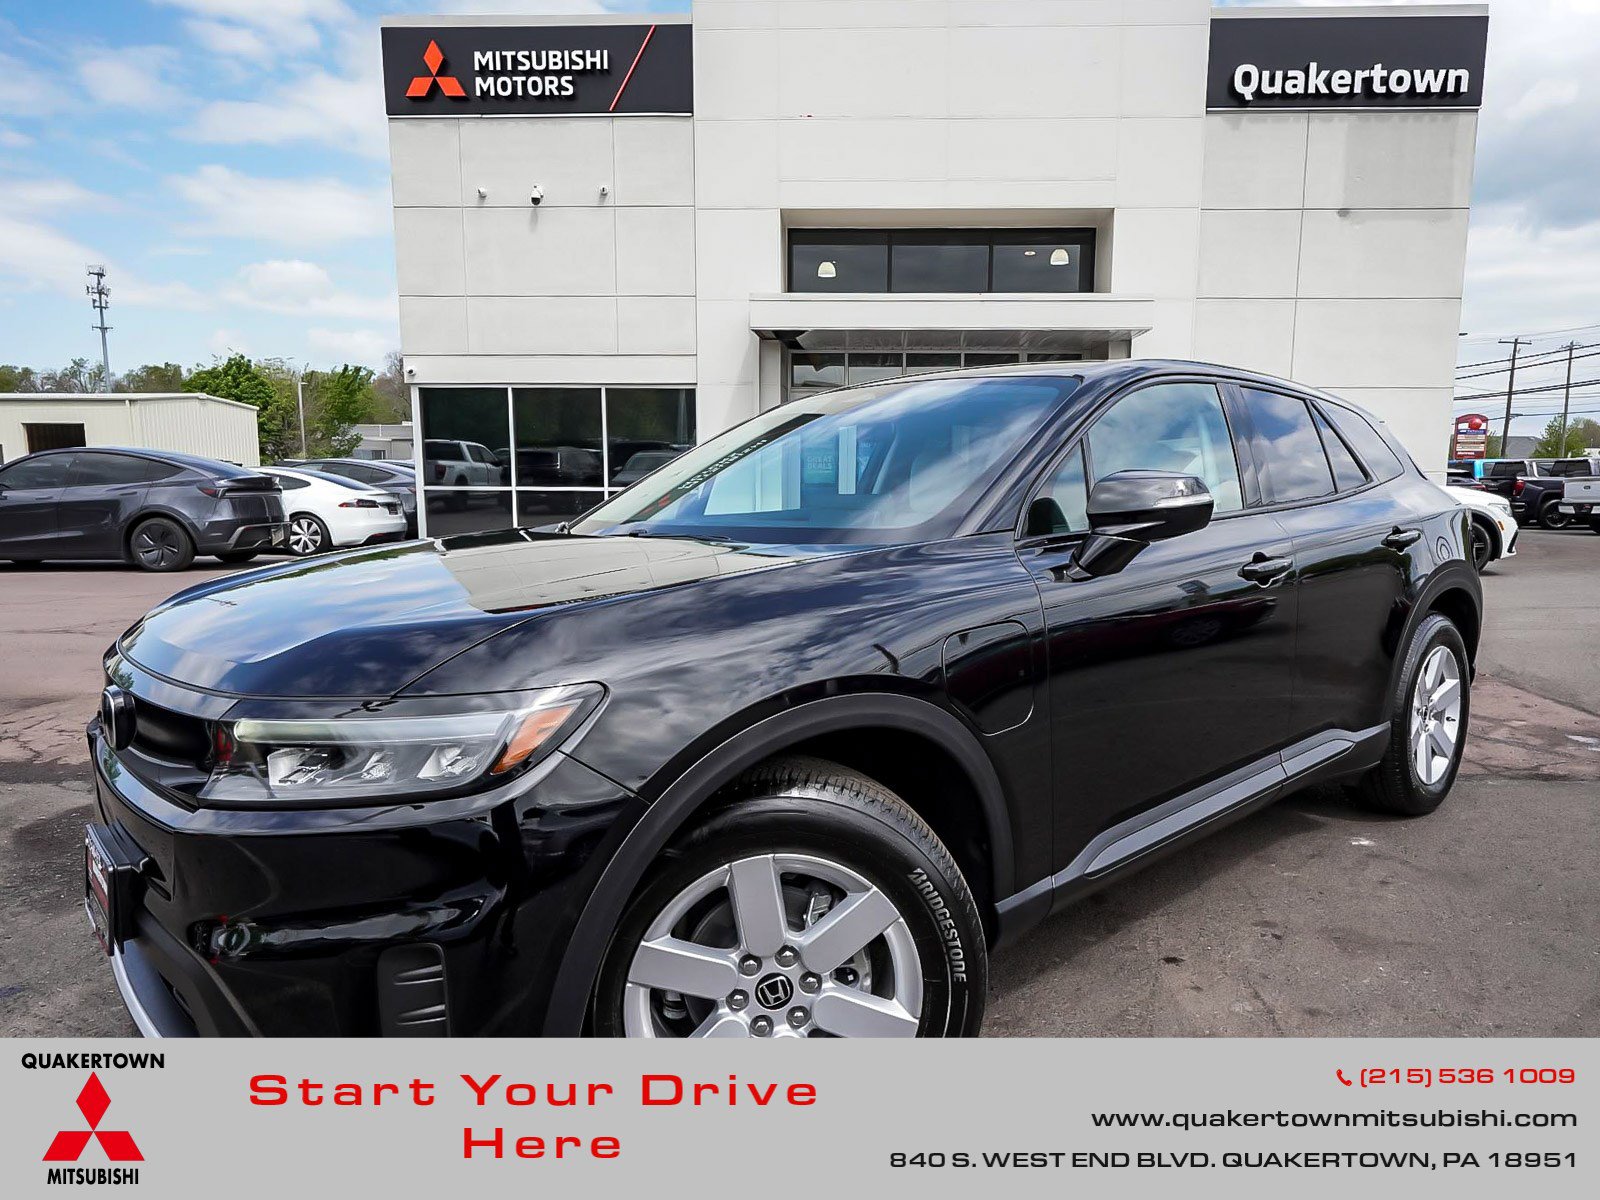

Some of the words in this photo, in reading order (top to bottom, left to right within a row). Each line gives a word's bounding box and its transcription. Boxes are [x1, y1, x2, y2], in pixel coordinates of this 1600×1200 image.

[473, 49, 609, 71] MITSUBISHI
[475, 75, 574, 97] MOTORS
[1233, 61, 1470, 101] Quakertown
[907, 867, 967, 983] BRIDGESTONE
